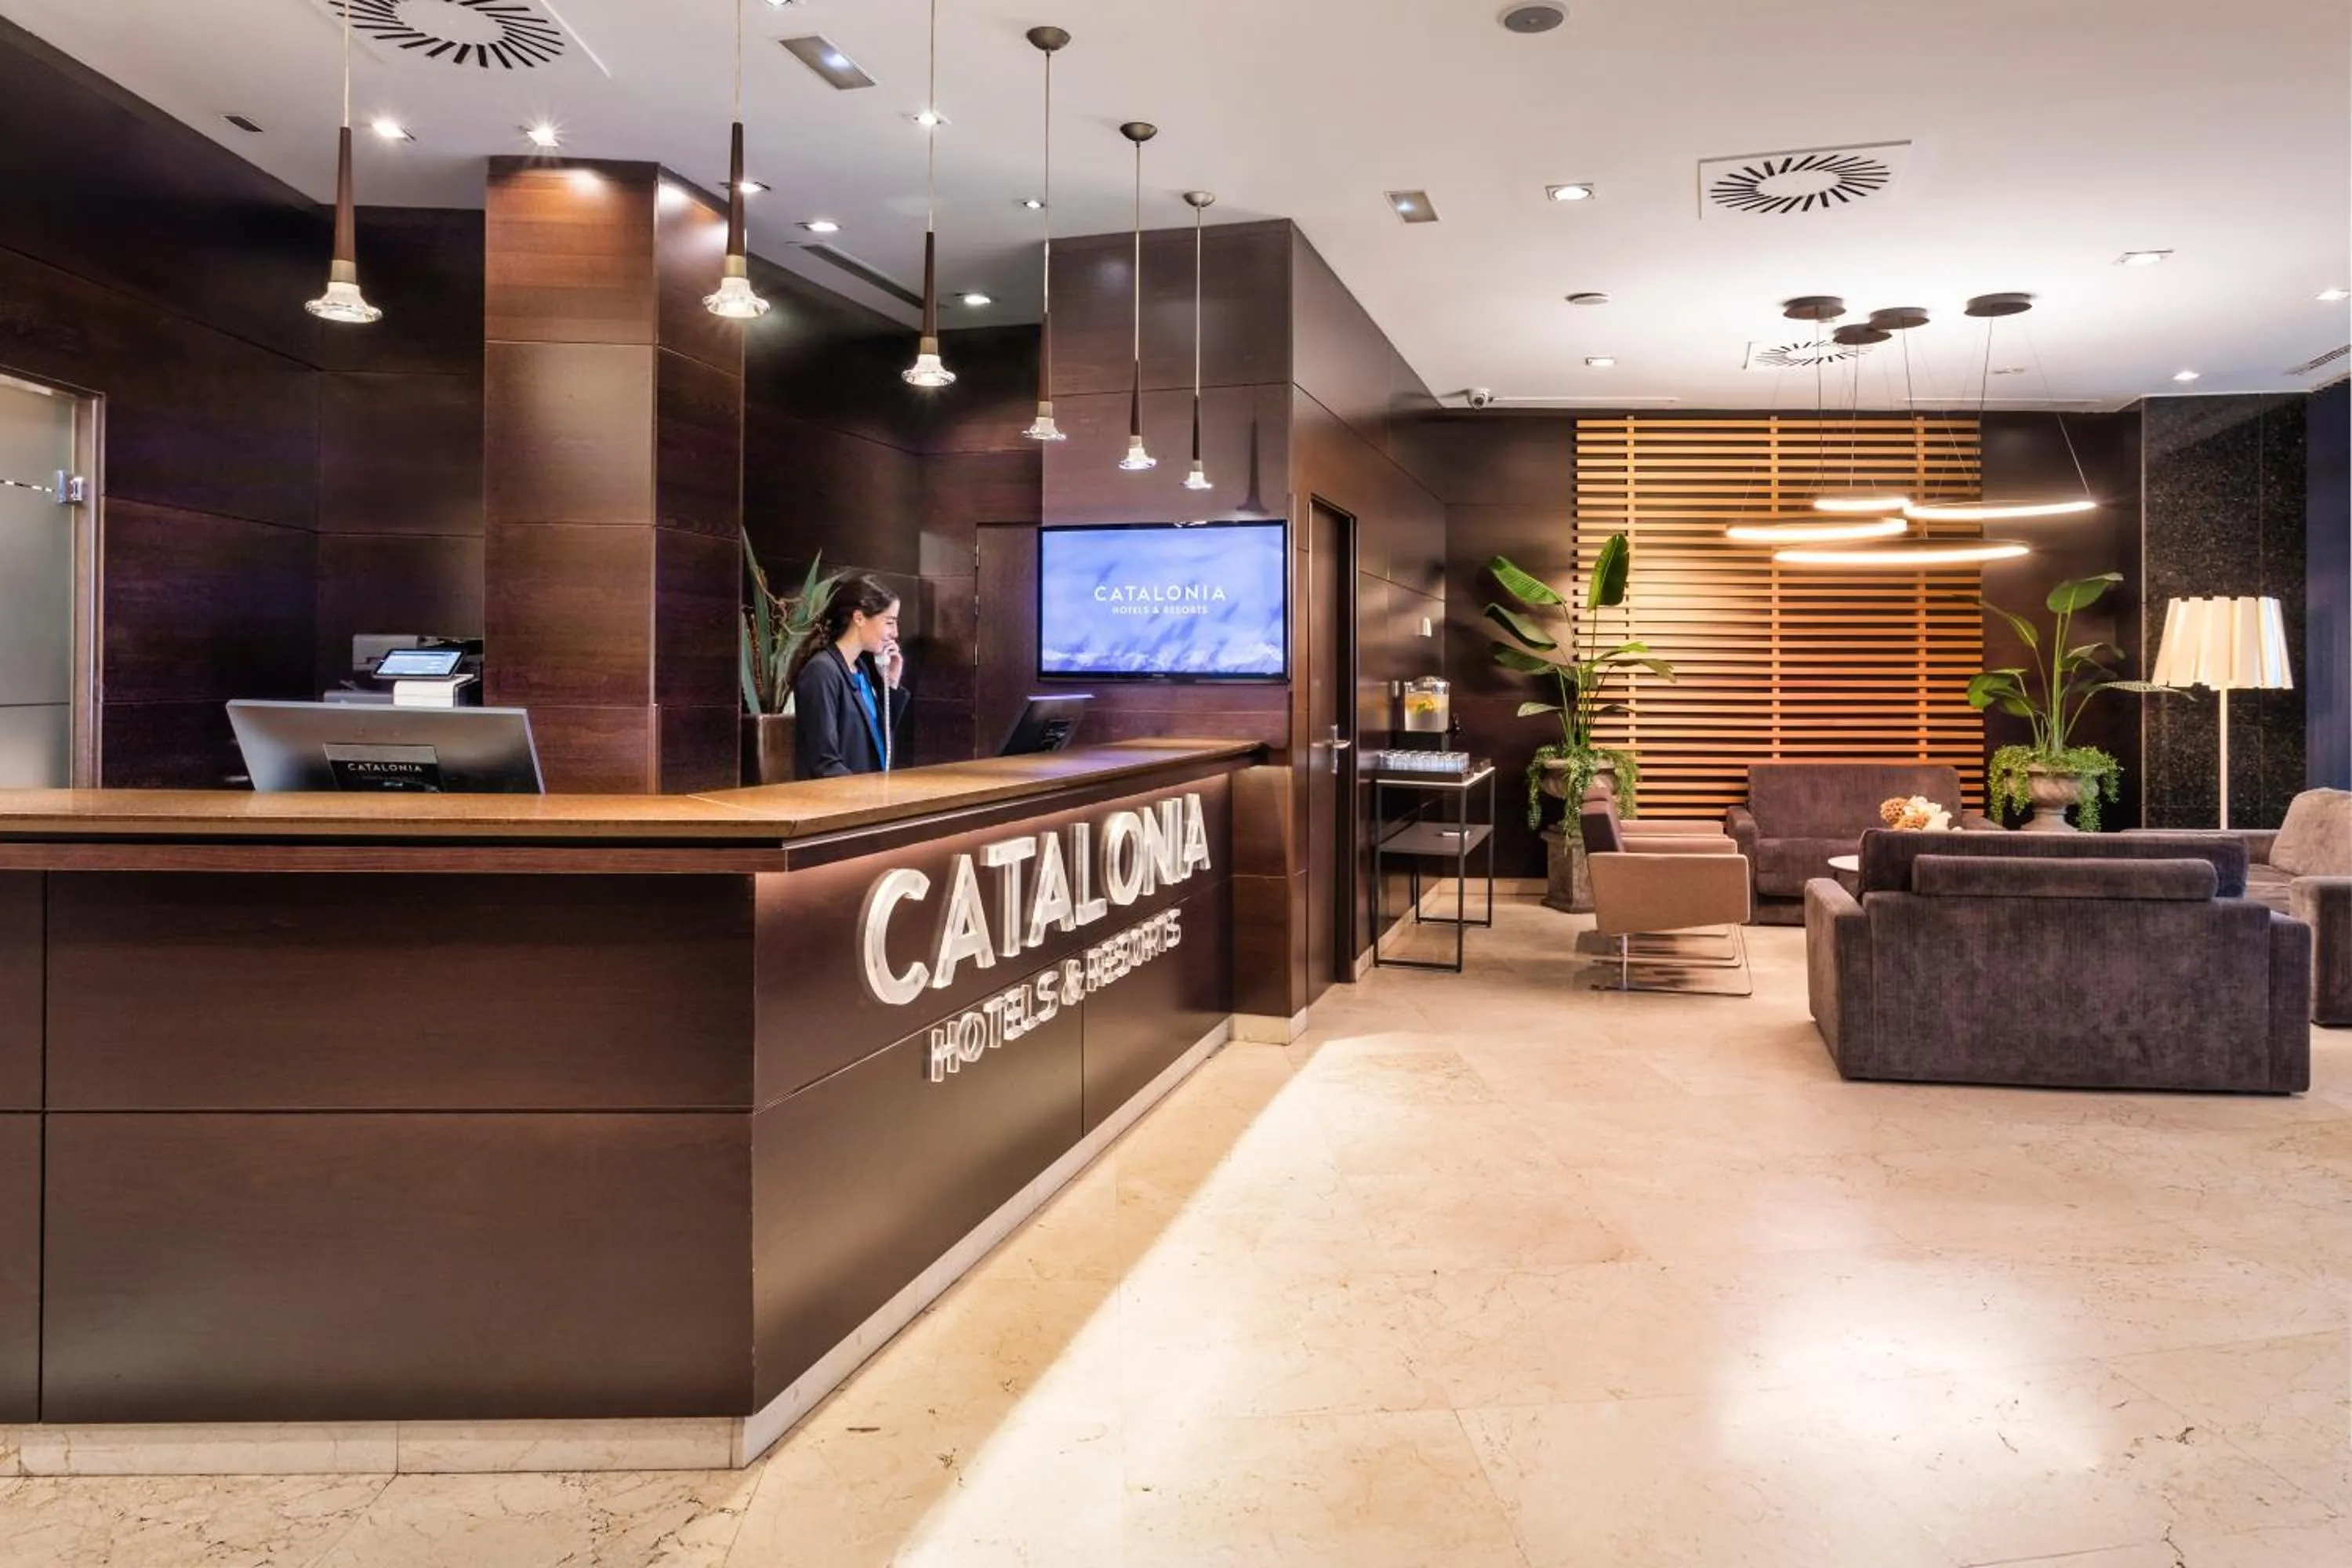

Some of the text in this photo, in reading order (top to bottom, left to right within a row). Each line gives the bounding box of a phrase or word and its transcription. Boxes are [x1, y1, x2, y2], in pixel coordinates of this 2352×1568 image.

[1094, 584, 1226, 602] CATALONIA
[1112, 605, 1149, 615] HOTELS
[1163, 605, 1209, 615] RESORTS
[347, 763, 423, 772] CATALONIA
[862, 793, 1211, 1005] CATALONIA
[931, 908, 1181, 1083] HOTELS & RESORTS
